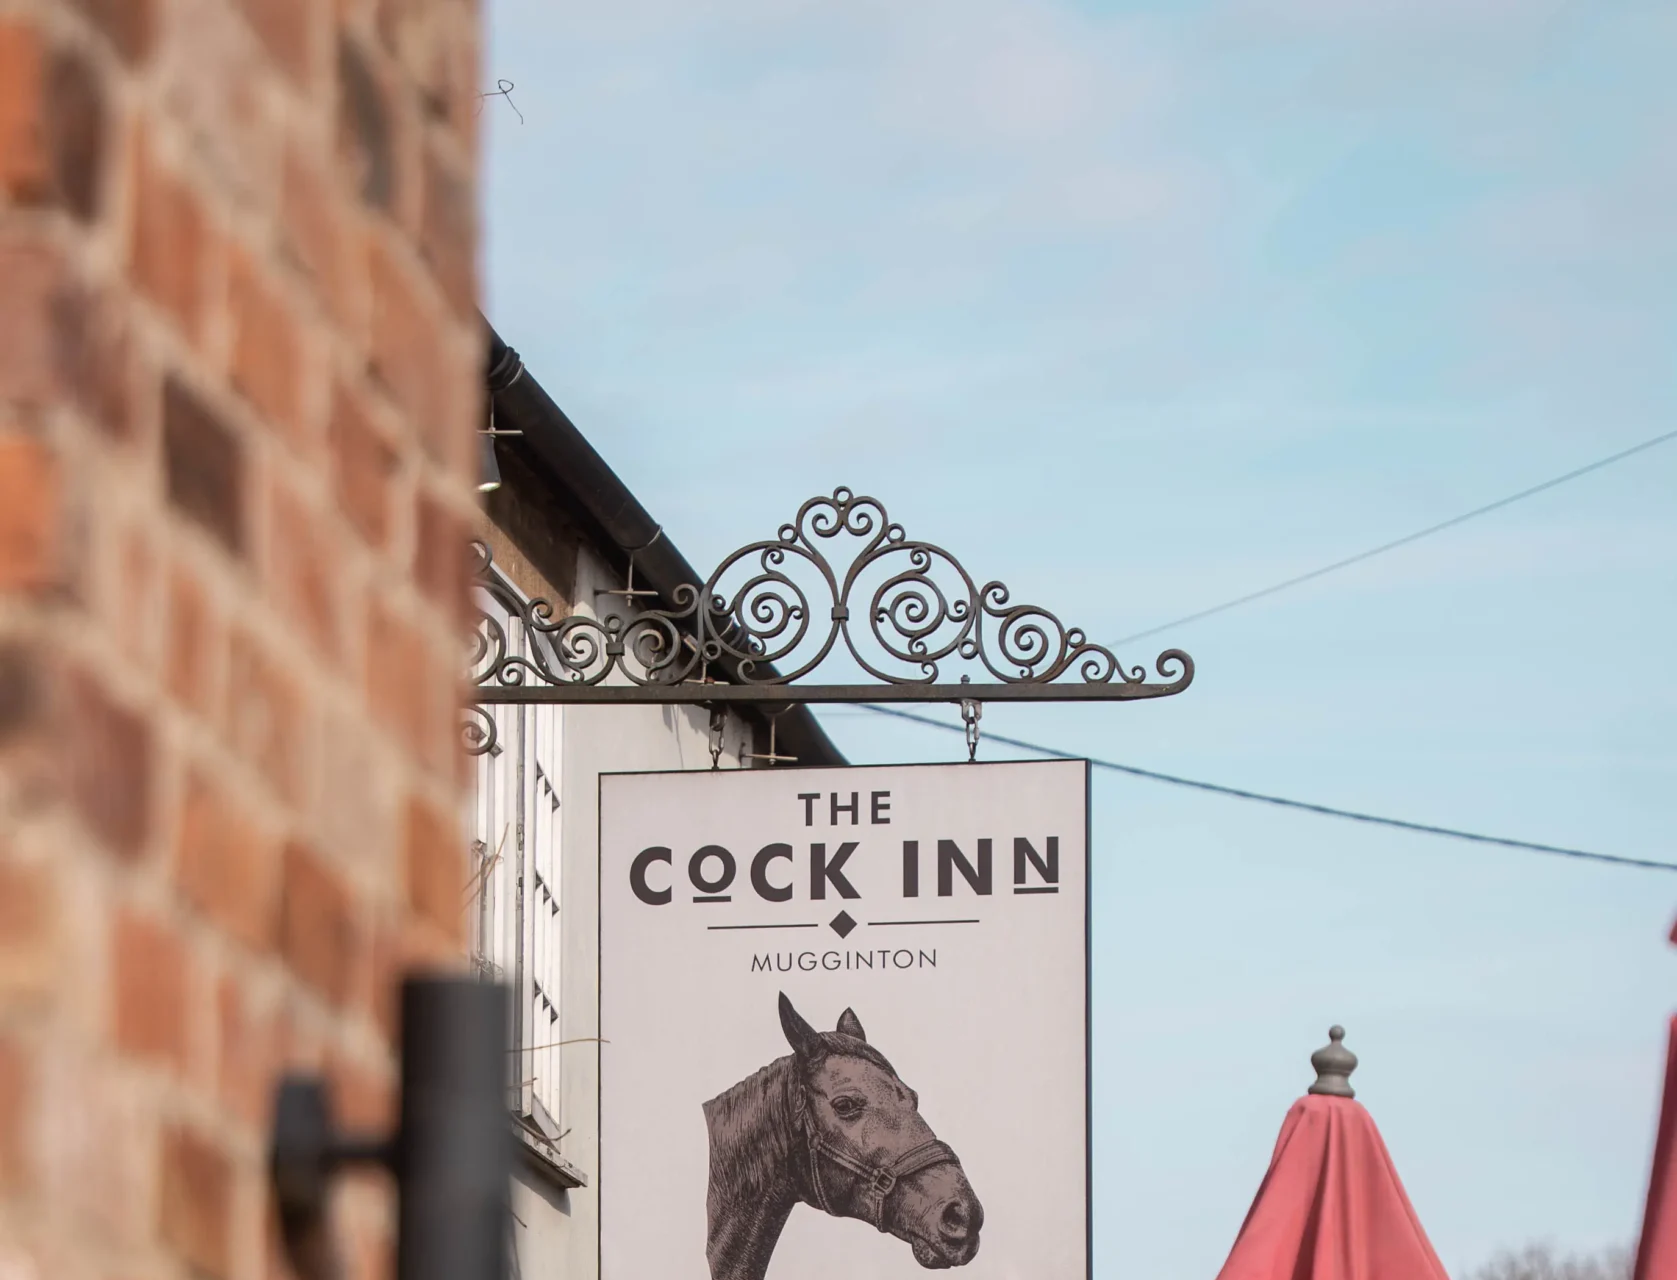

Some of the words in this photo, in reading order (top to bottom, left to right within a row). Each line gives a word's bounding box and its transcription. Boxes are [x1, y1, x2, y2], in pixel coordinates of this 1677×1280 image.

[798, 791, 891, 826] THE
[630, 842, 861, 905] COCK
[903, 836, 1059, 897] INN
[751, 949, 937, 973] MUGGINTON
